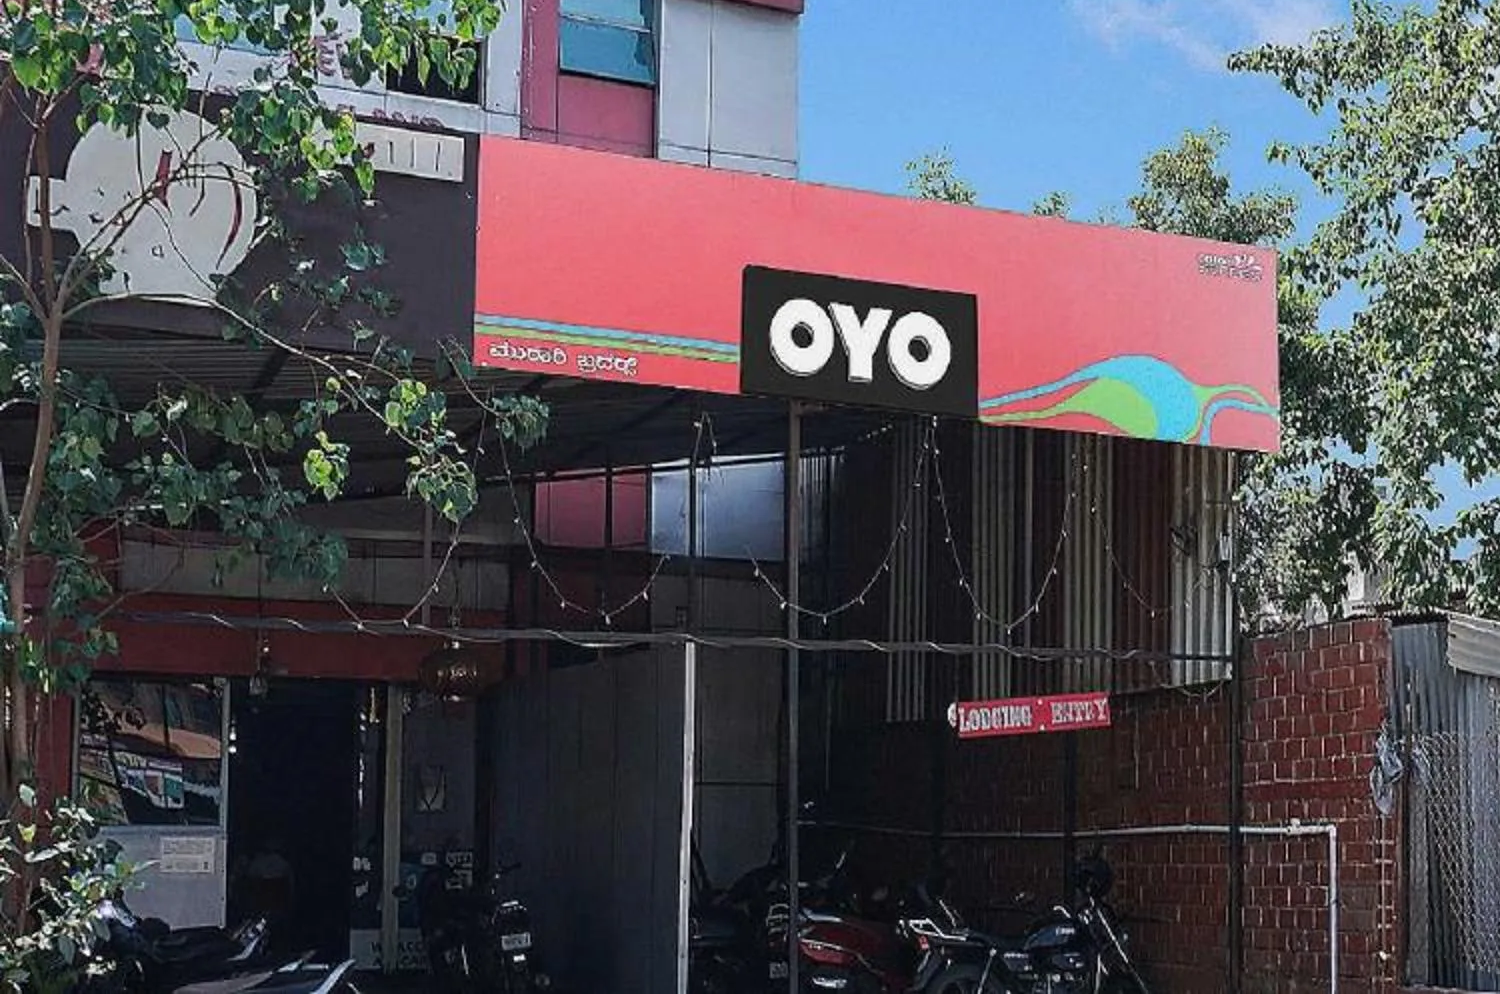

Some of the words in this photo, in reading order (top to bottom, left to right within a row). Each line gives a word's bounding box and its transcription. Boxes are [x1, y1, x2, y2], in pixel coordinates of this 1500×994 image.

[769, 298, 951, 391] OYO
[959, 705, 1032, 733] LODGING
[1050, 697, 1107, 725] ENTRY
